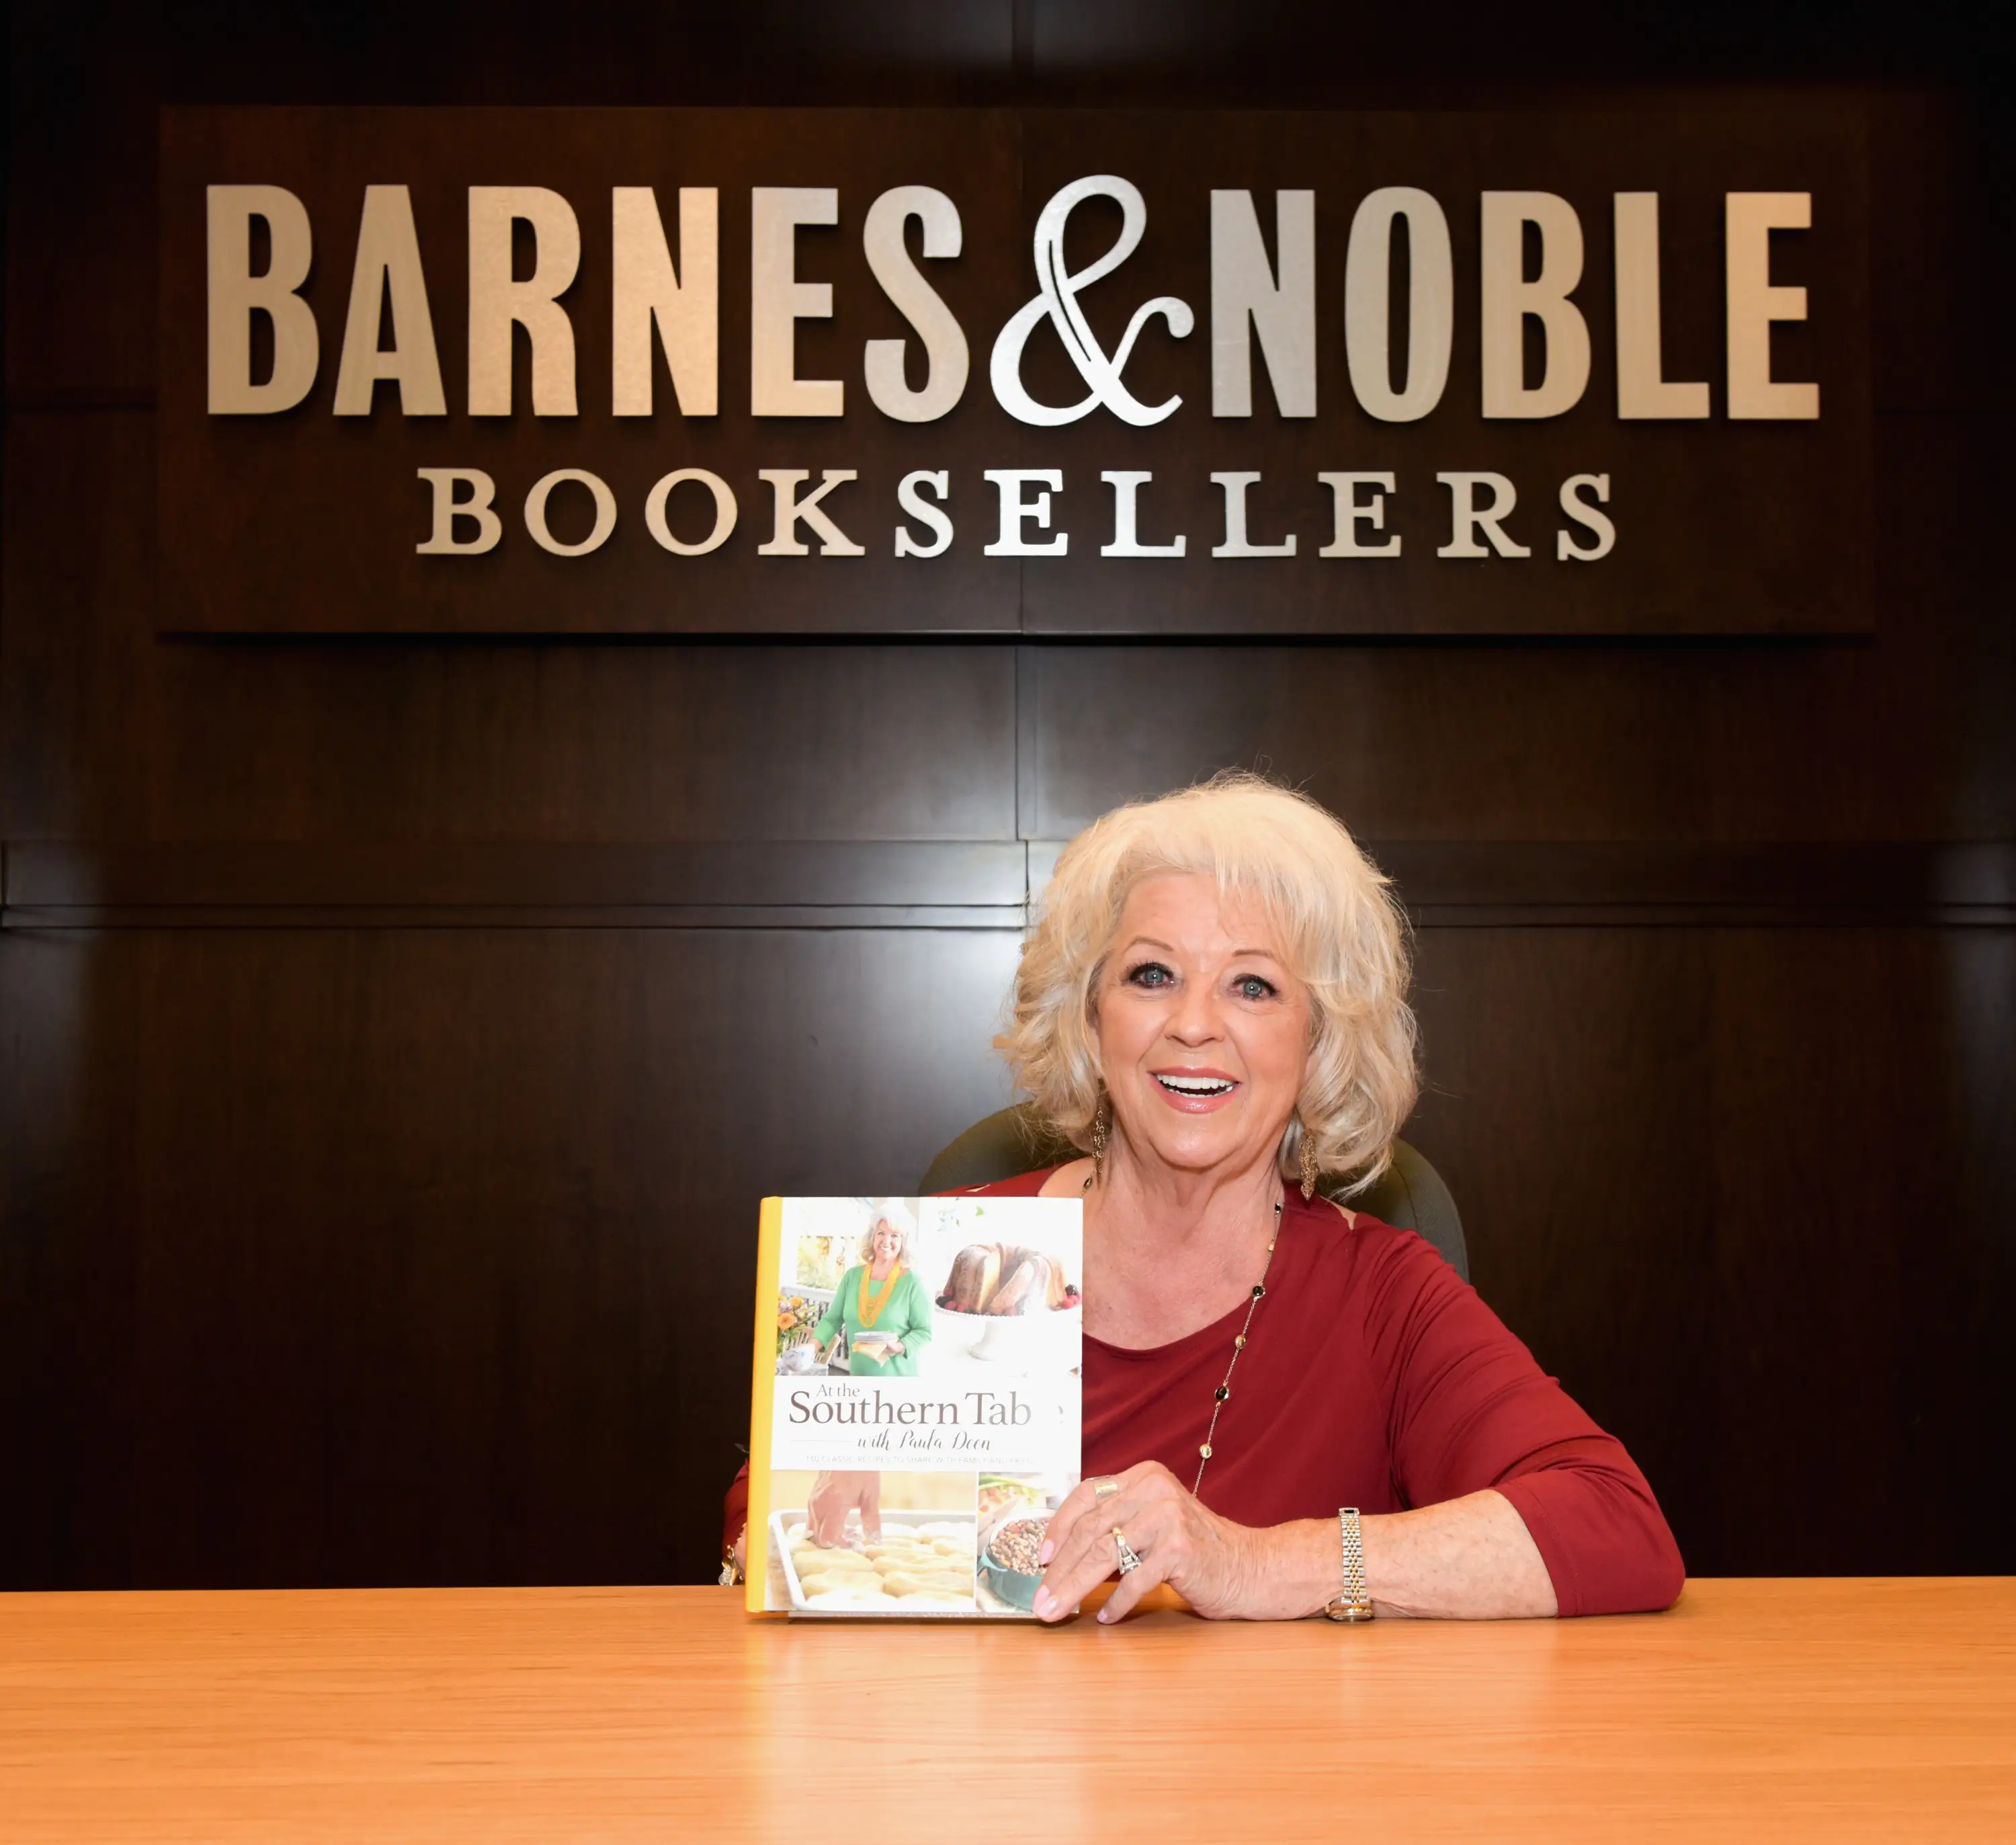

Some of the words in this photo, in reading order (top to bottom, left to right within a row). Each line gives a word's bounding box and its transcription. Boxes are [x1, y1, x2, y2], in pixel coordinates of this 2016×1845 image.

[415, 468, 1616, 561] BOOKSELLERS
[816, 1383, 833, 1397] At
[837, 1383, 861, 1397] the
[789, 1389, 960, 1424] Southern
[964, 1391, 1064, 1426] Tab
[857, 1428, 890, 1451] with
[899, 1428, 943, 1451] Paula
[951, 1430, 991, 1451] Deen
